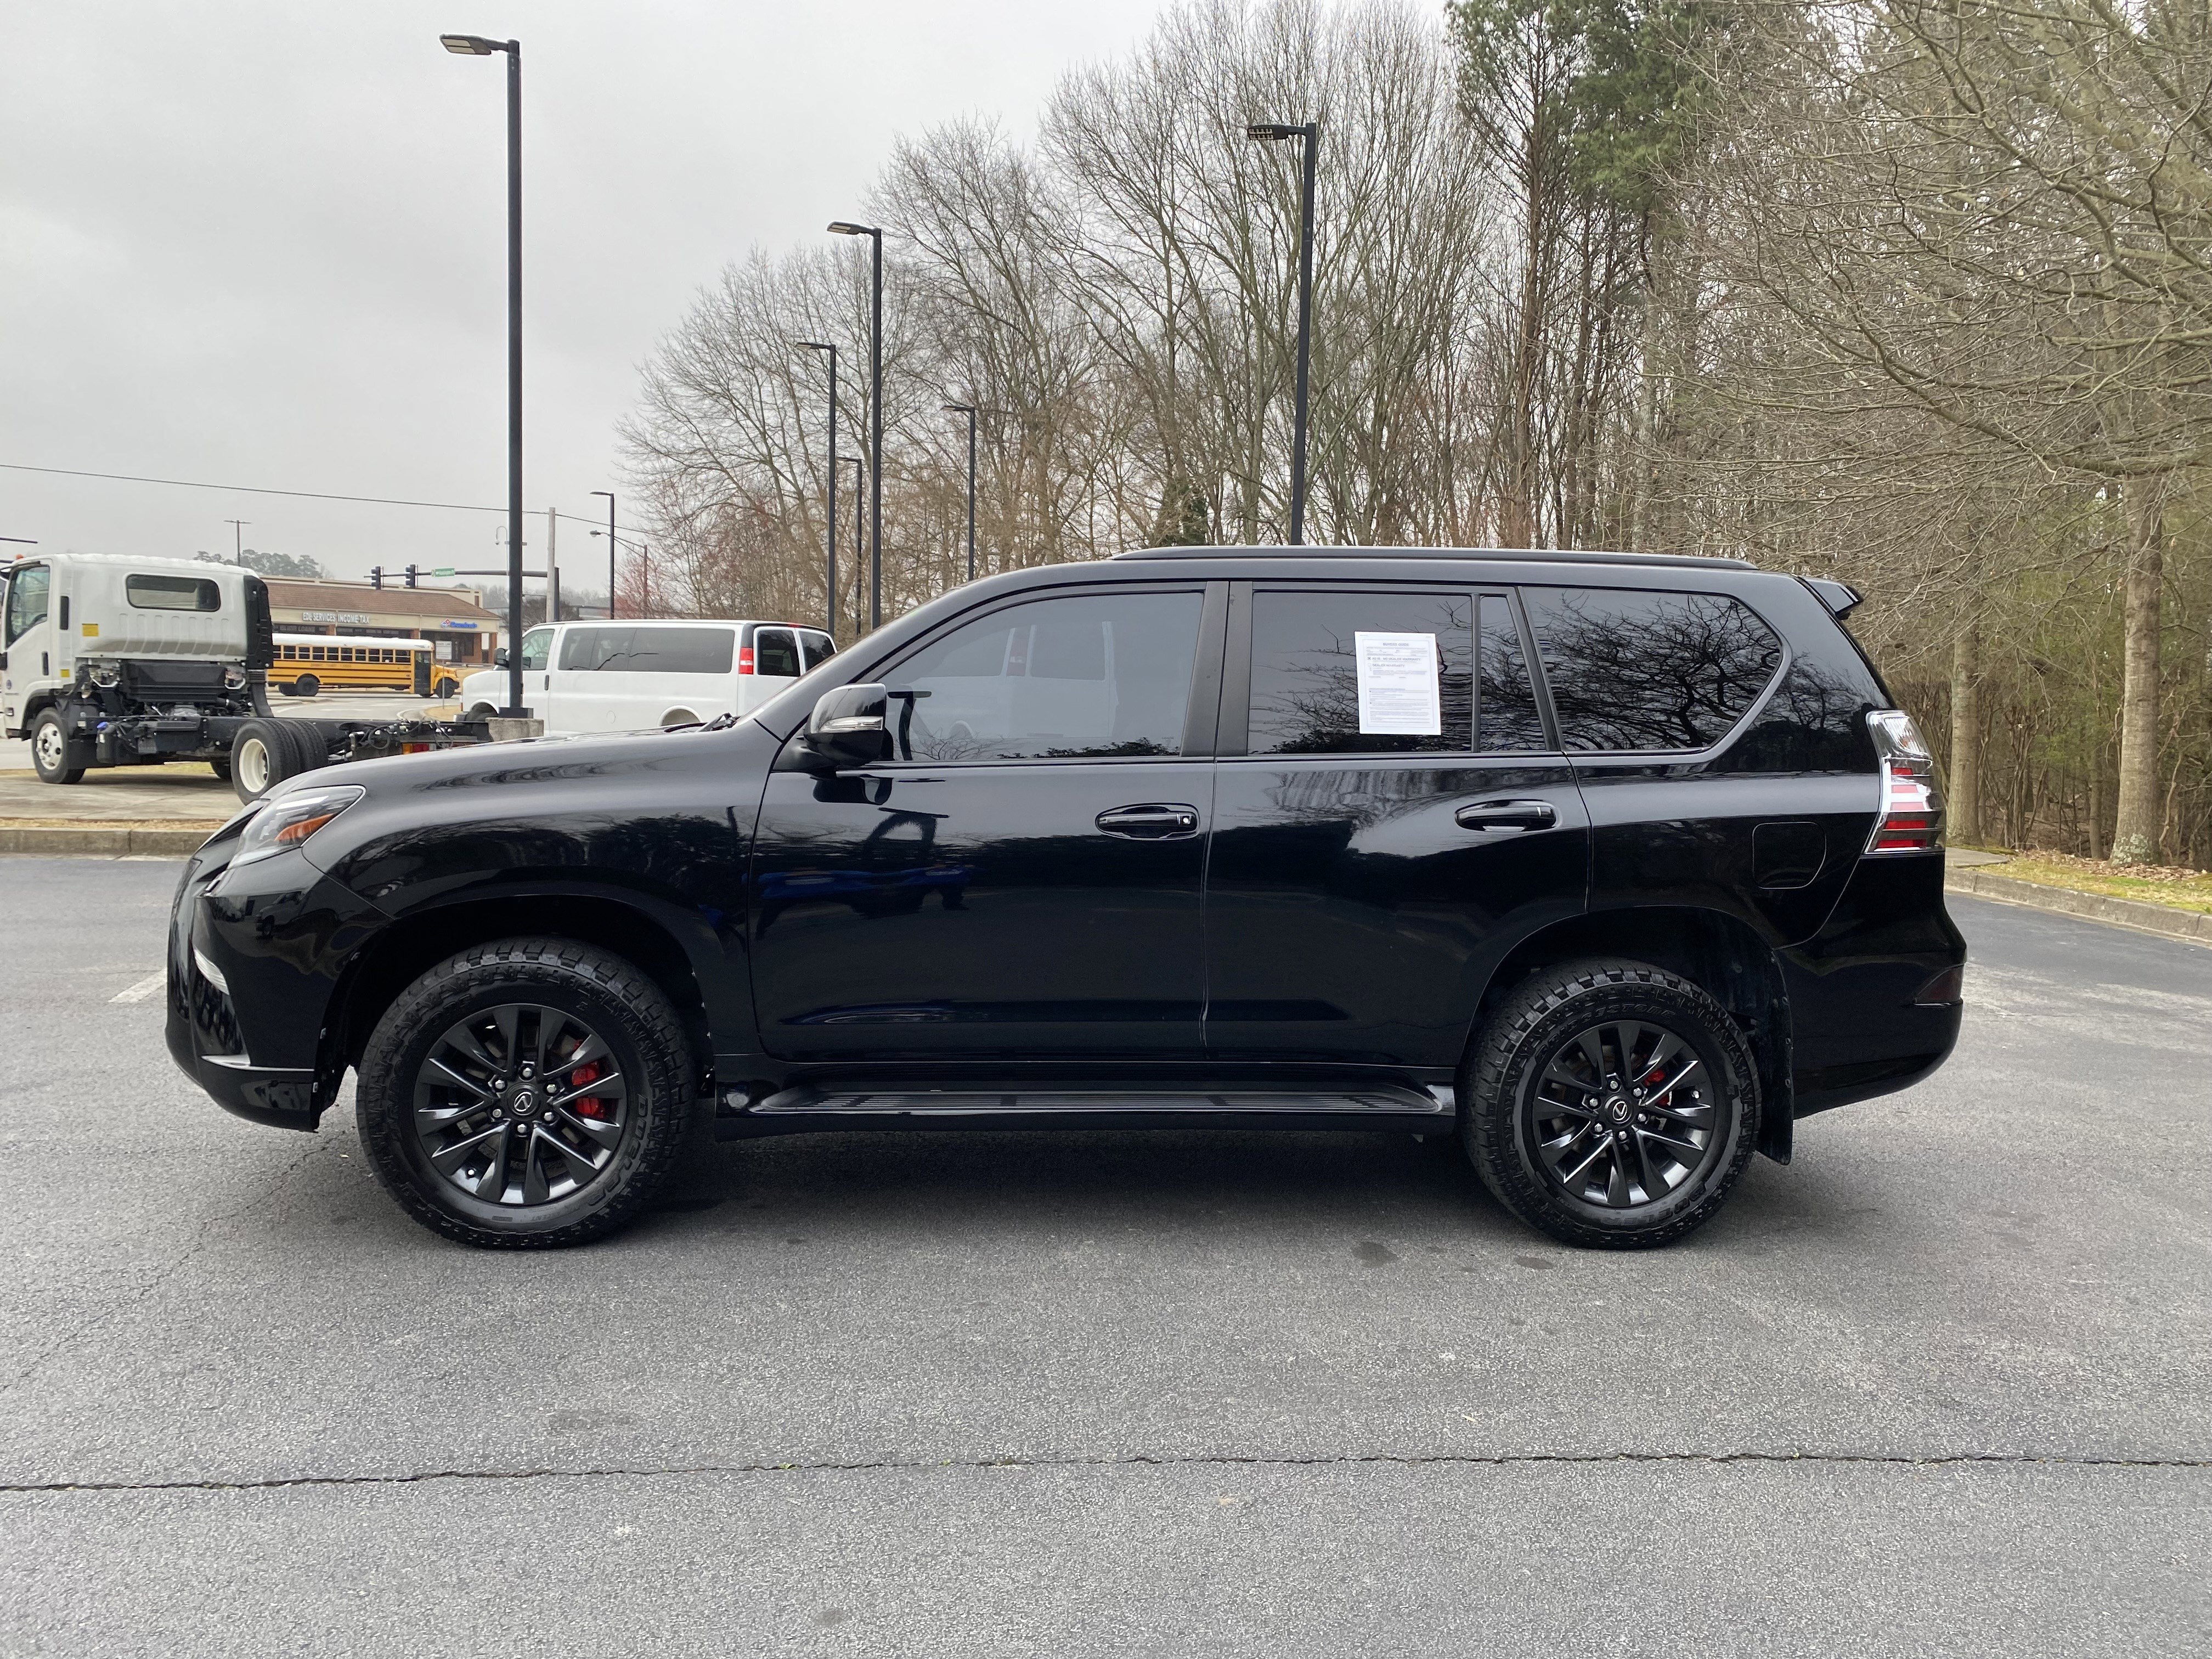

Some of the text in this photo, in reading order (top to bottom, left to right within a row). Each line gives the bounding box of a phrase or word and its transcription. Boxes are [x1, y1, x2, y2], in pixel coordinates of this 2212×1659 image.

[337, 614, 358, 623] INCOME
[359, 614, 369, 624] TAX
[589, 1093, 648, 1206] DUELER
